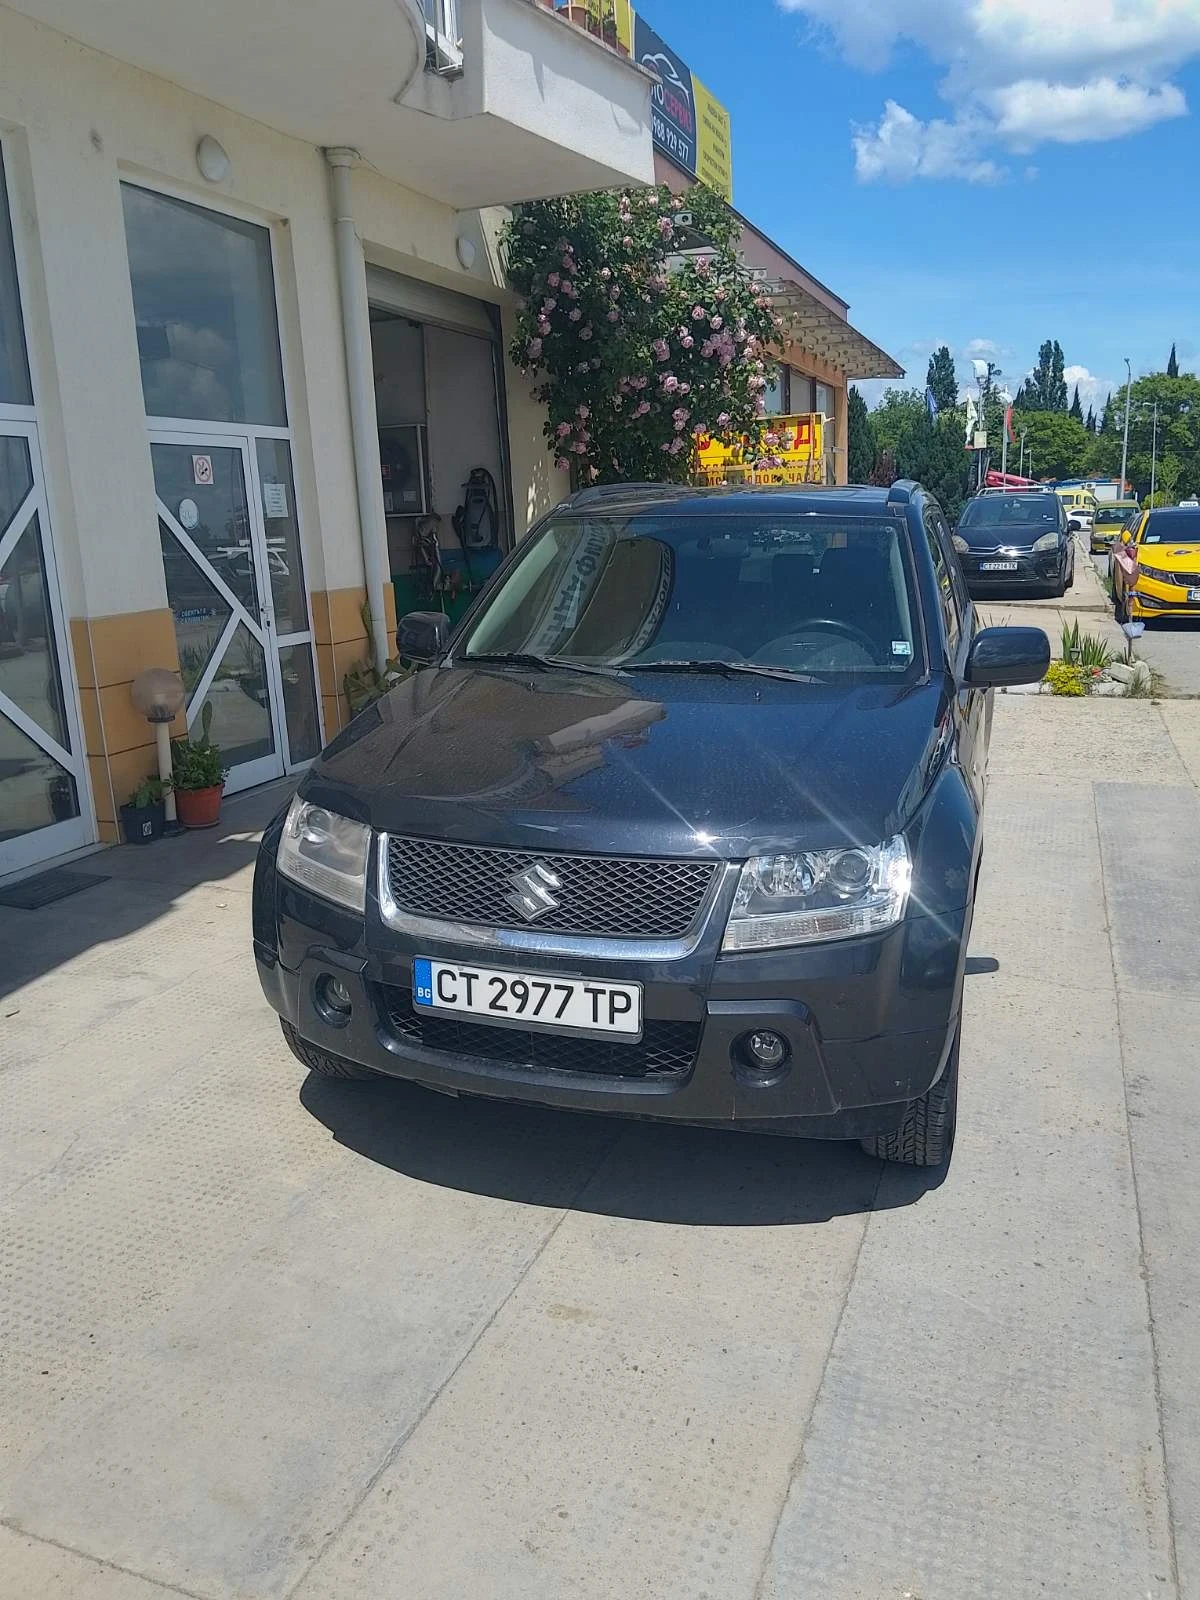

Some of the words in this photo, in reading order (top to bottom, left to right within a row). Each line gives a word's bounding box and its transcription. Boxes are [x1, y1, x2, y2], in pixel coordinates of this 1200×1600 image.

[678, 140, 689, 163] 577
[417, 987, 431, 999] BG
[436, 969, 479, 1006] CT
[488, 976, 574, 1019] 2977
[584, 987, 632, 1025] TP
